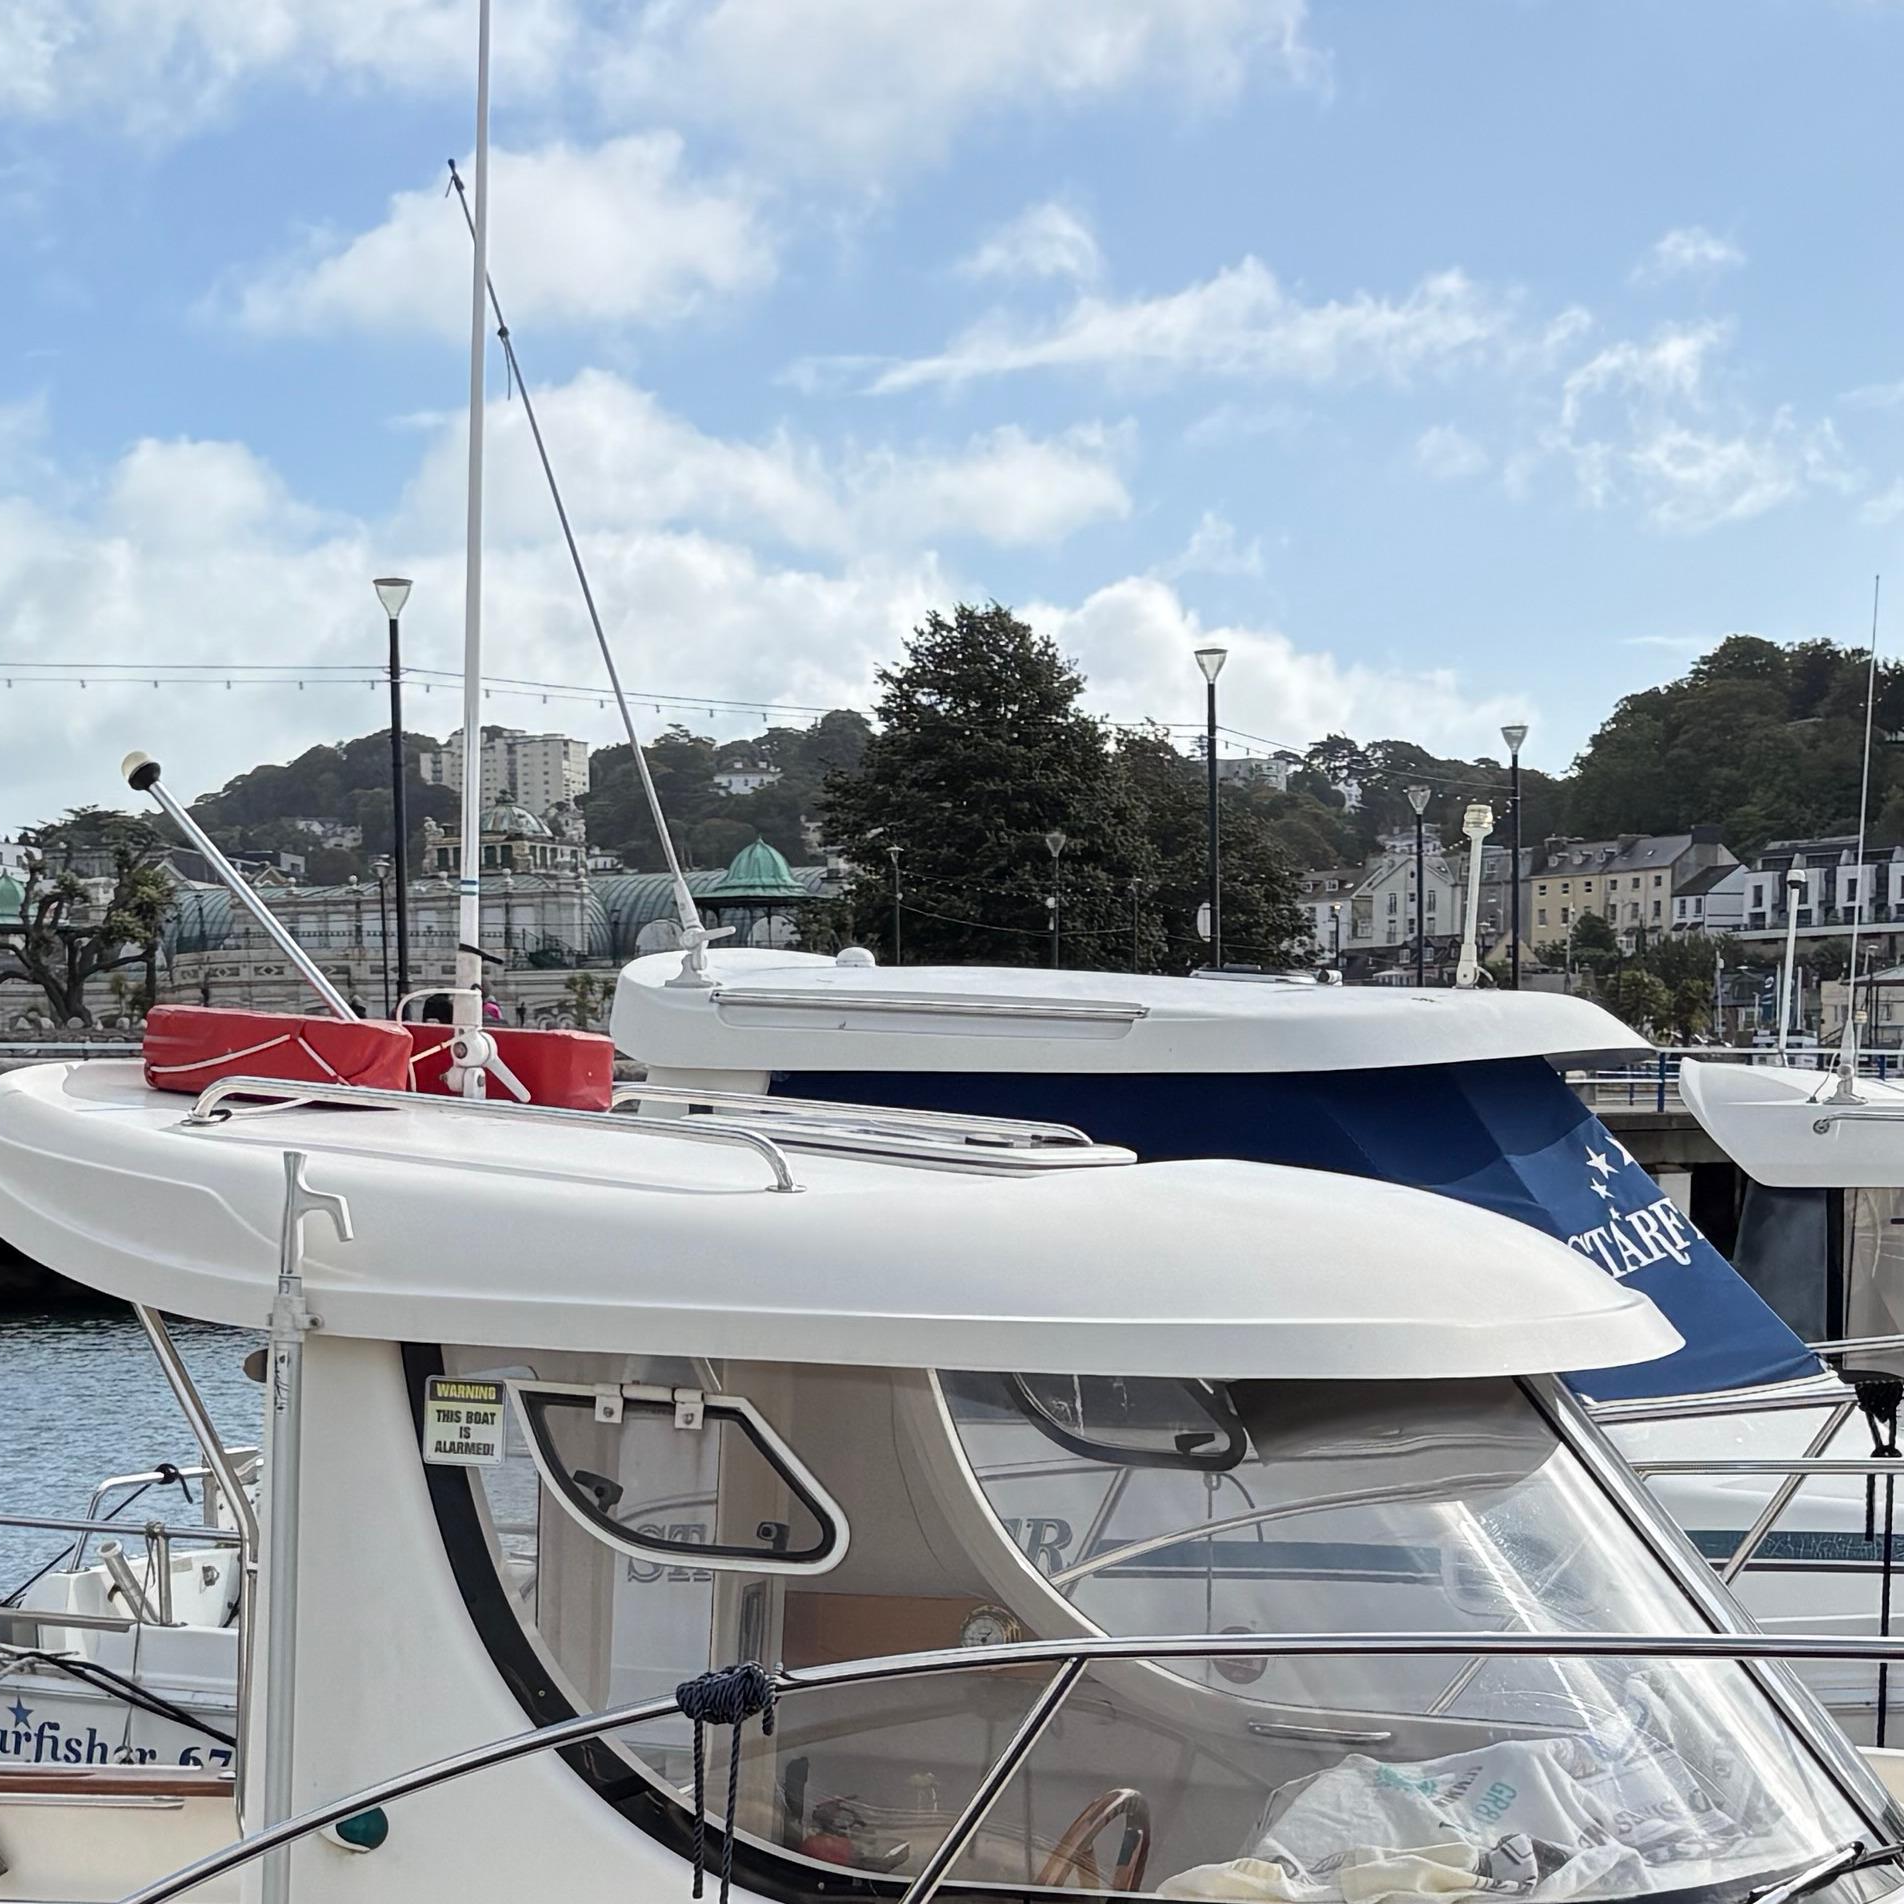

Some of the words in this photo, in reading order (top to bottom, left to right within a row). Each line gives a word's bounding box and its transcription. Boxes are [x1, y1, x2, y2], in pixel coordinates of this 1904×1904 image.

[1567, 1197, 1705, 1279] TARF
[436, 1382, 497, 1401] WARNING
[436, 1409, 462, 1424] THIS
[465, 1410, 497, 1426] BOAT
[459, 1426, 471, 1440] IS
[434, 1440, 496, 1457] ALARMED!
